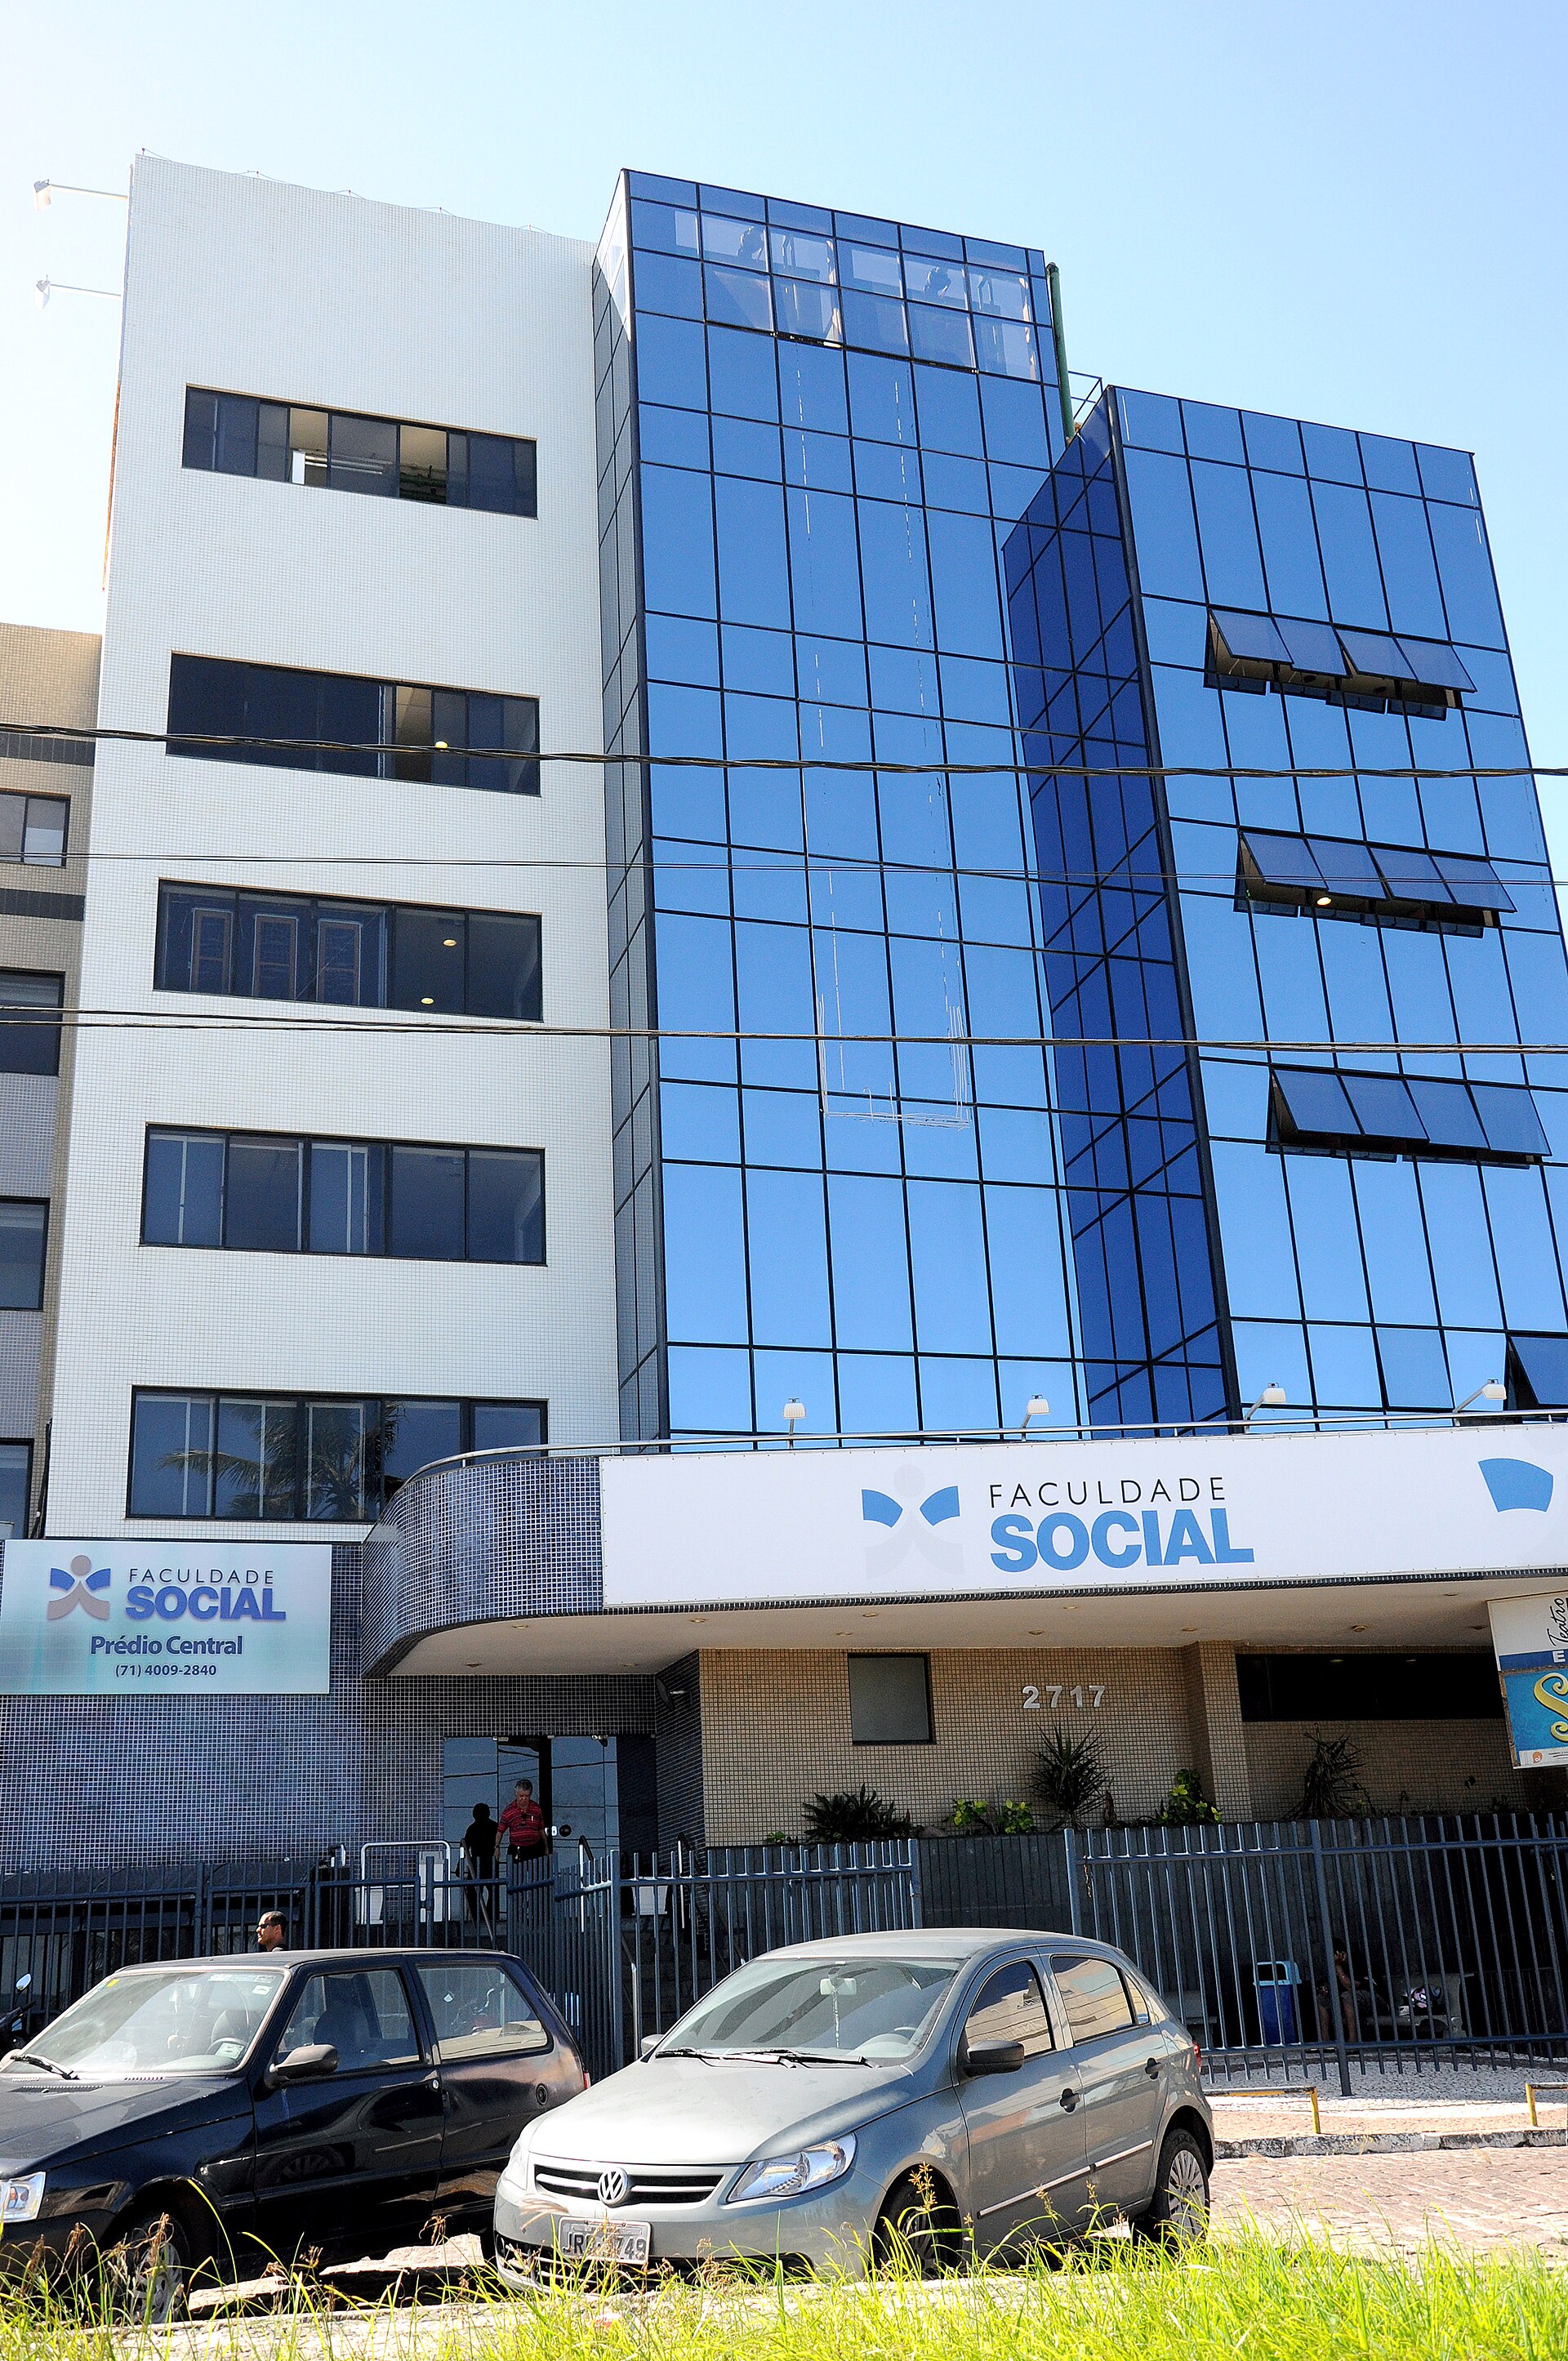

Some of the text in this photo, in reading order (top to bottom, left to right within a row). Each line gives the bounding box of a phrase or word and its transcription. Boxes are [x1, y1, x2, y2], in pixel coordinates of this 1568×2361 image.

[990, 1477, 1226, 1508] FACULDADE
[991, 1508, 1254, 1573] SOCIAL
[128, 1568, 274, 1584] FACULDADE
[125, 1585, 287, 1621] SOCIAL
[91, 1635, 243, 1655] Prédio Central
[115, 1664, 217, 1678] (71) 4009-2840
[1022, 1685, 1106, 1709] 2717
